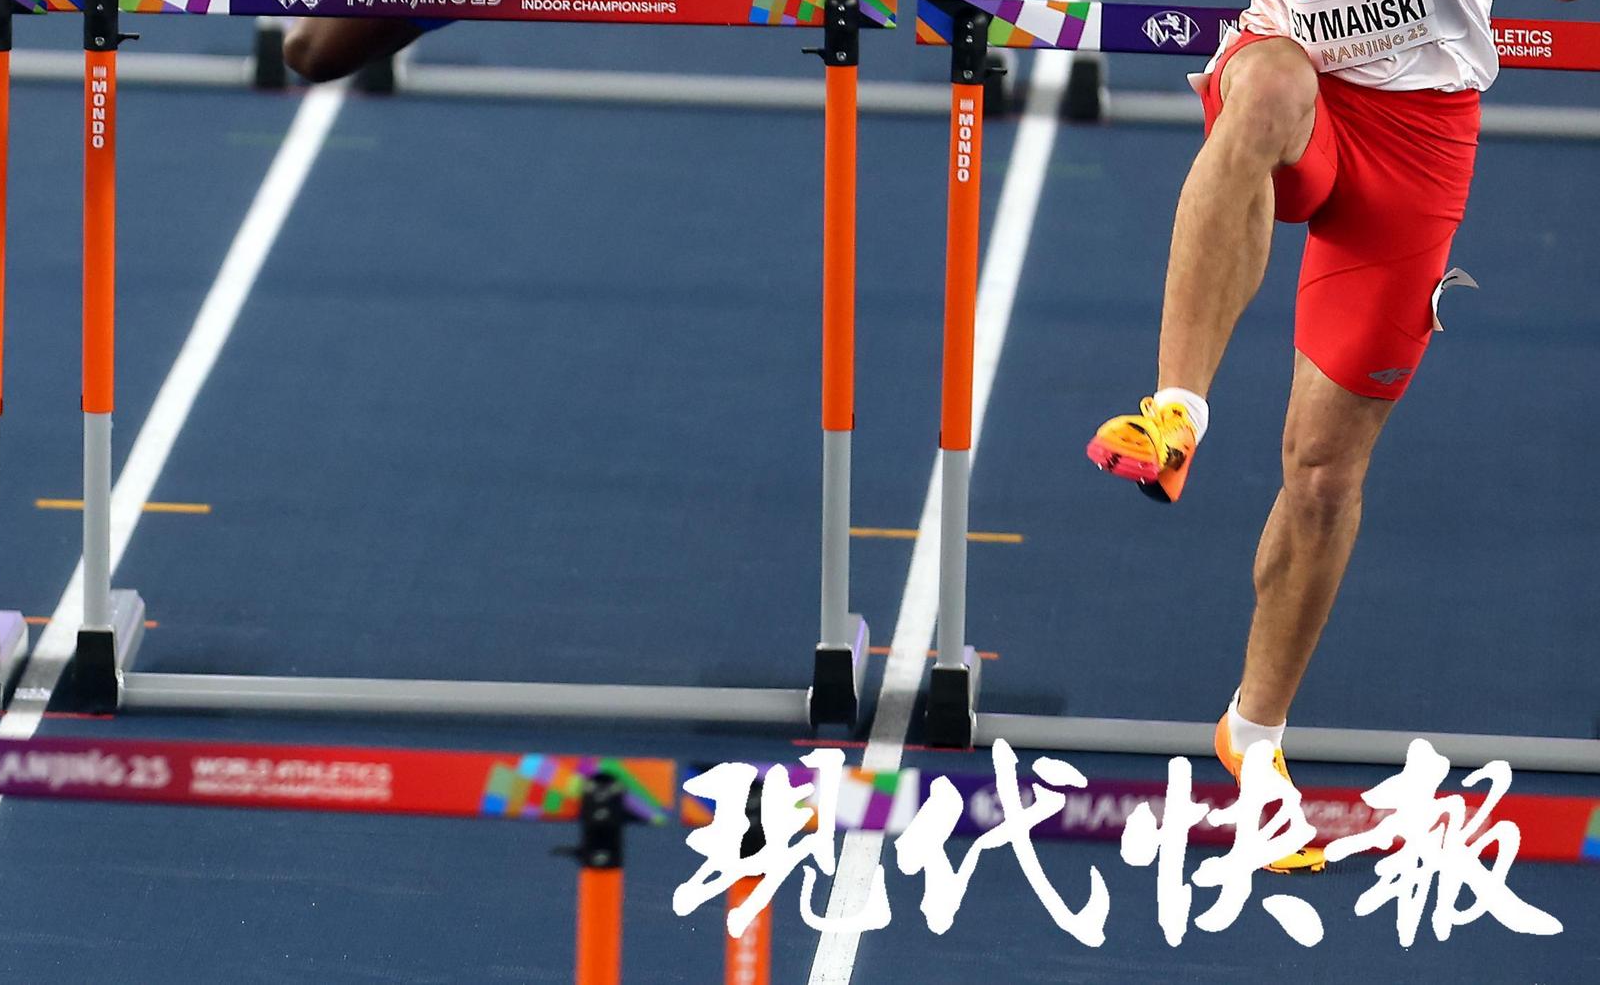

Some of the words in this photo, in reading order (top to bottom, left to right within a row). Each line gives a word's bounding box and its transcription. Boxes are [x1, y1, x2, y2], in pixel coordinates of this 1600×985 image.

[521, 0, 572, 11] INDOOR
[573, 1, 677, 14] CHAMPIONSHIPS
[1321, 34, 1405, 66] NANJING
[1407, 23, 1428, 42] 25
[92, 80, 107, 149] MONDO
[957, 113, 975, 182] MONDO
